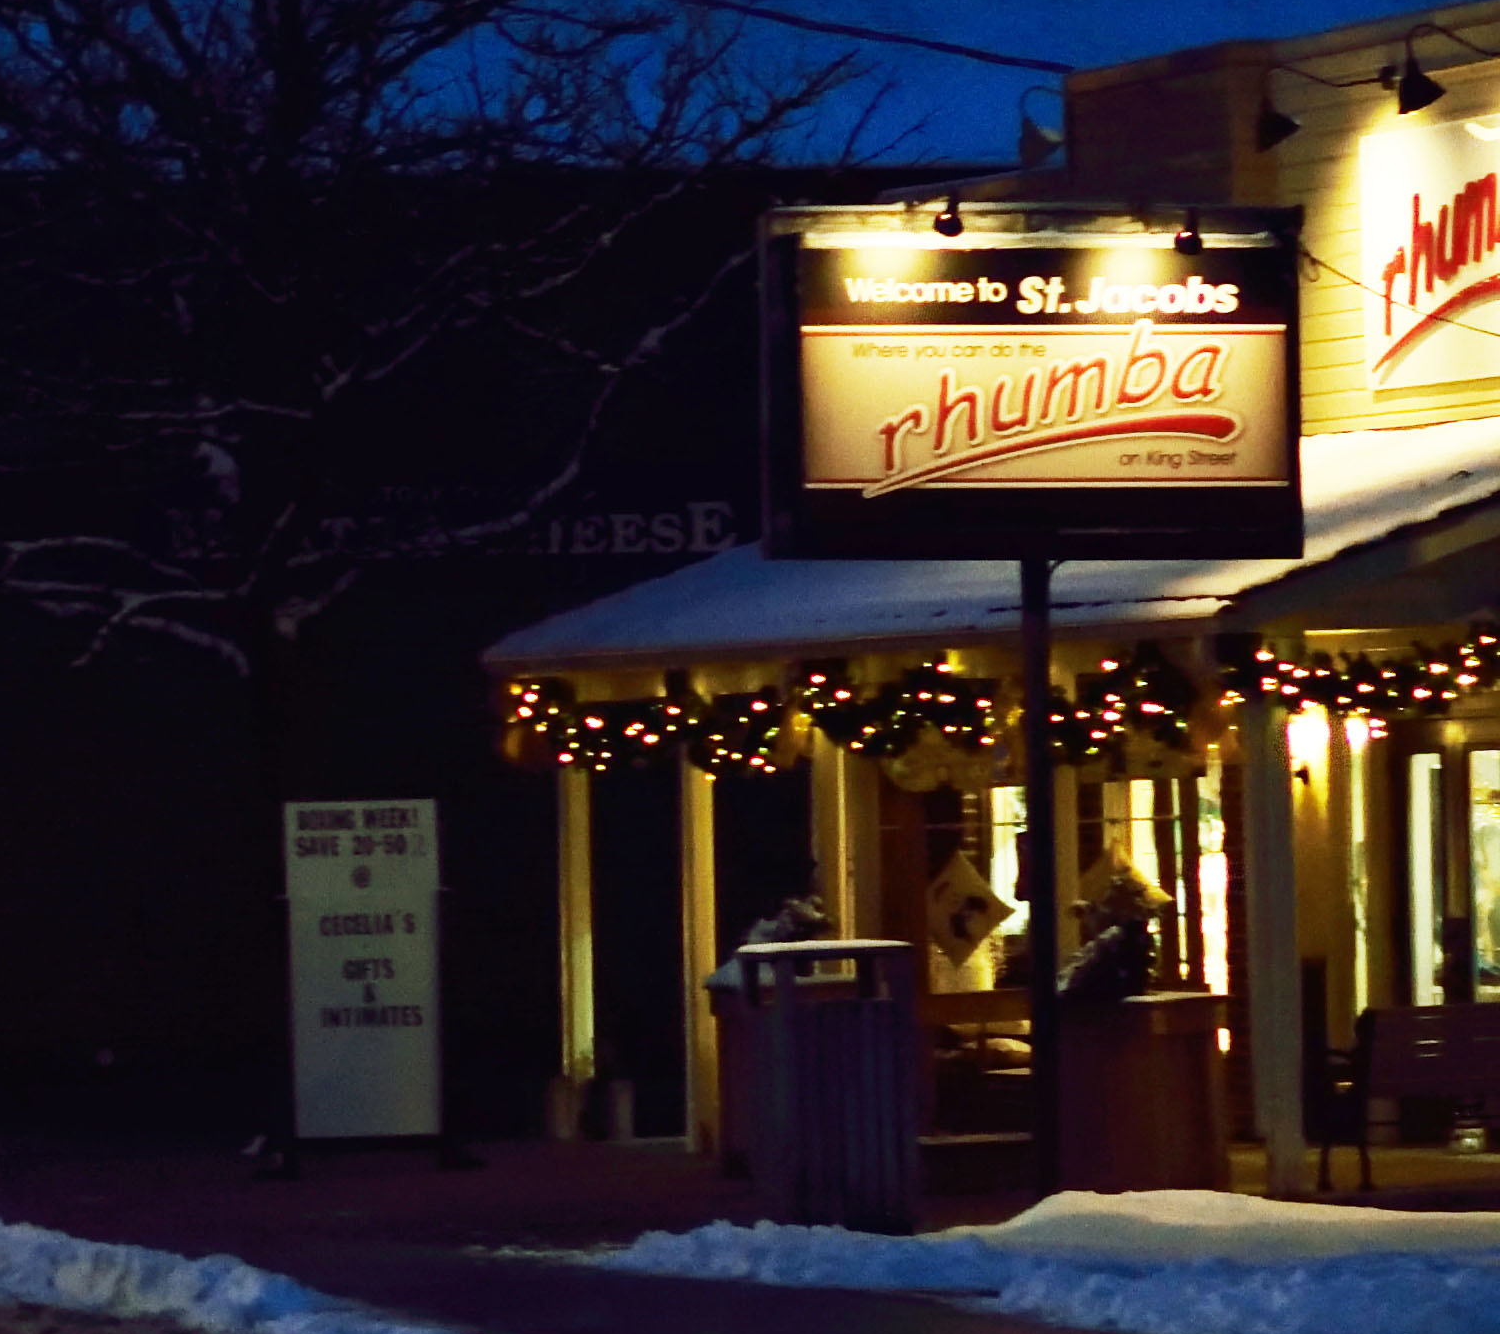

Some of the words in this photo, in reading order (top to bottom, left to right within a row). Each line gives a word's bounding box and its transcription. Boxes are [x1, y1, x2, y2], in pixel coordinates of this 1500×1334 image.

[1381, 173, 1500, 336] rhum
[846, 277, 974, 303] Welcome
[978, 277, 1008, 303] to
[1016, 276, 1071, 315] St.
[1076, 276, 1240, 315] Jacobs
[852, 341, 908, 359] Where
[914, 344, 946, 361] you
[950, 344, 987, 359] can
[991, 342, 1014, 359] do
[1017, 341, 1048, 359] the
[879, 321, 1228, 473] rhumba
[1119, 452, 1142, 467] on
[1145, 450, 1181, 470] King
[1187, 449, 1237, 467] Street
[295, 835, 341, 857] SAVE
[342, 958, 395, 981] GIFTS
[320, 1005, 424, 1029] INTIMATES
